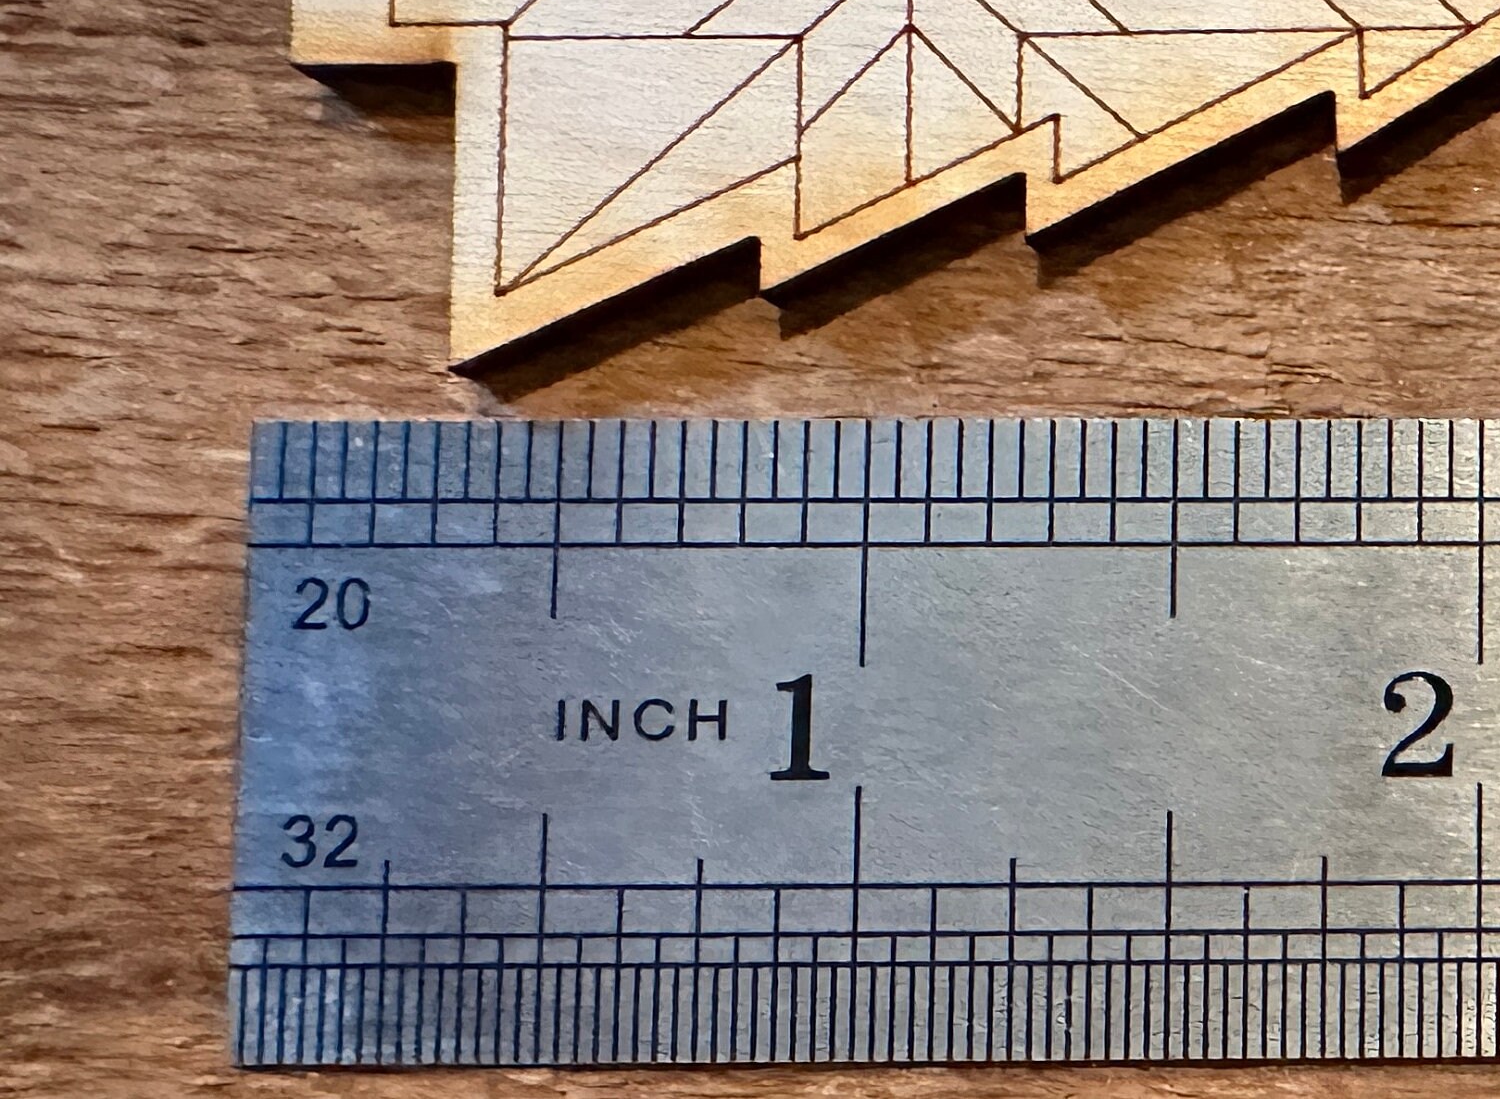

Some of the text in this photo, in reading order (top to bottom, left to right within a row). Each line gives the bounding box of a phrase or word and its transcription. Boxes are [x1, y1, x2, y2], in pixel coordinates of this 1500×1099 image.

[293, 577, 371, 631] 20
[556, 697, 729, 743] INCH
[769, 673, 830, 782] 1
[1381, 670, 1454, 779] 2
[281, 814, 359, 869] 32
